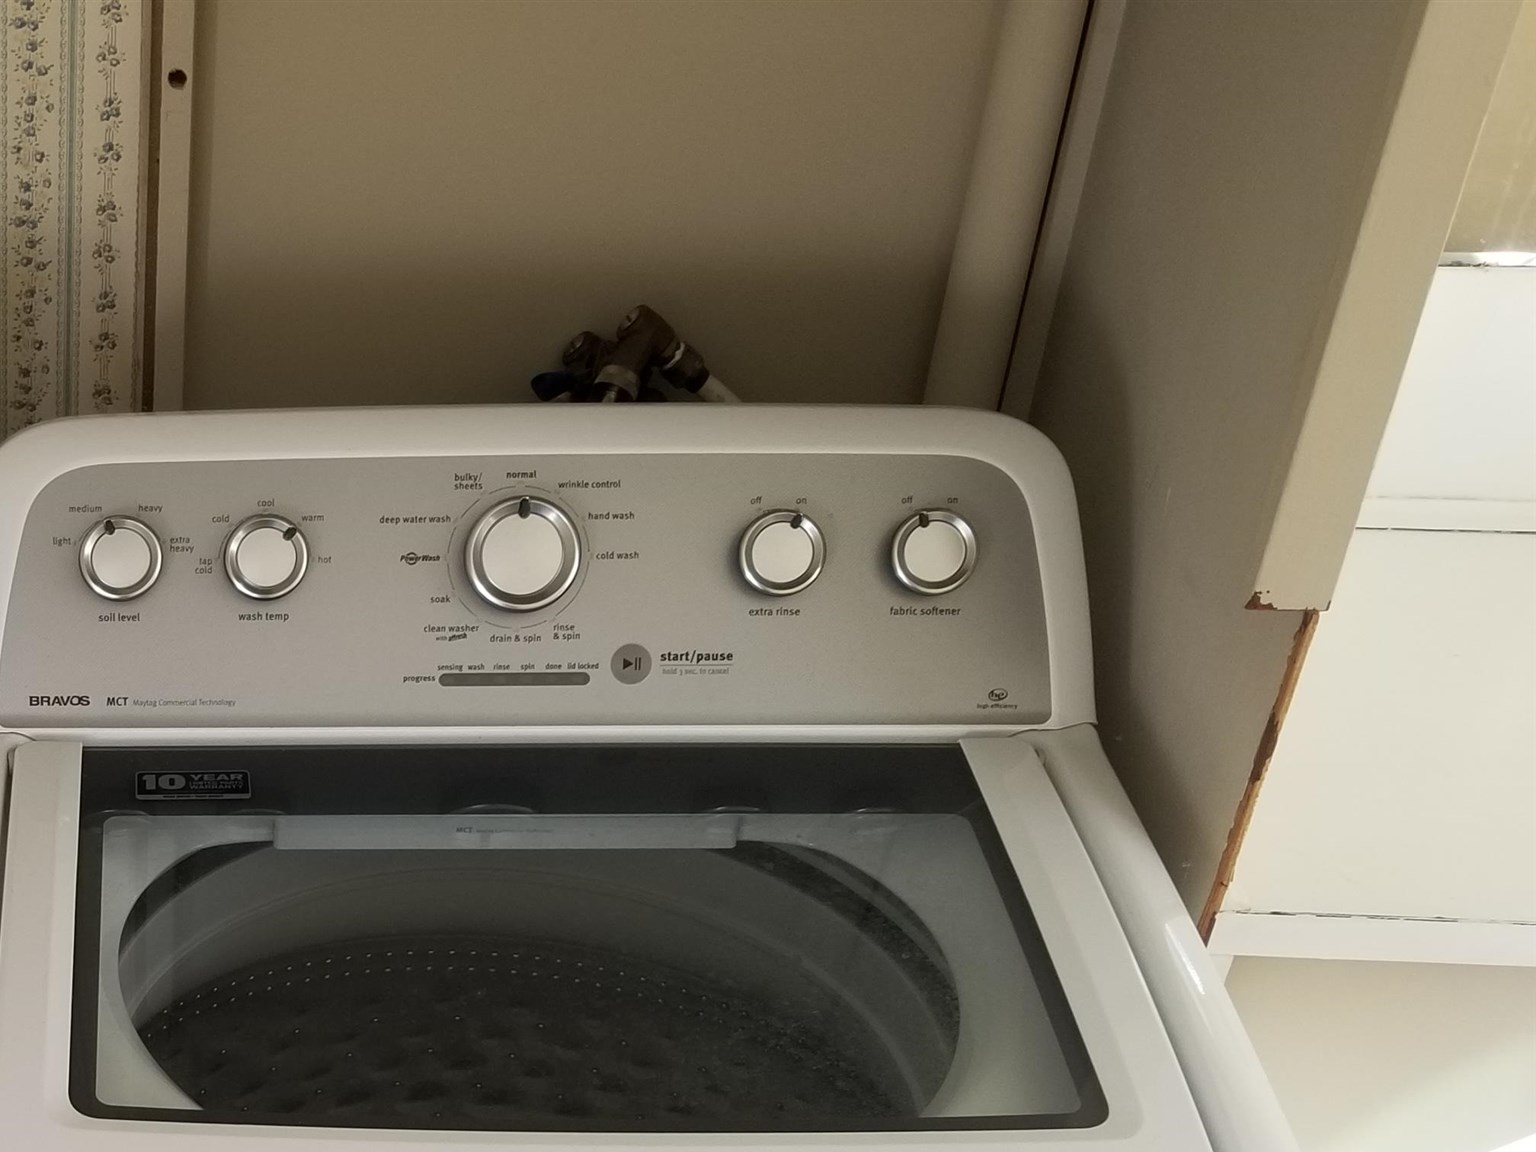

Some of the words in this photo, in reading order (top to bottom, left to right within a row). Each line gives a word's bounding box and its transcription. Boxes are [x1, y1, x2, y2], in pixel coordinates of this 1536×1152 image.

[454, 472, 483, 483] bulky/
[506, 470, 537, 479] normal
[454, 482, 483, 490] sheets
[558, 480, 589, 488] wrinkle
[591, 480, 621, 488] control
[257, 498, 275, 508] cool
[750, 496, 762, 505] off
[796, 497, 807, 505] on
[901, 495, 913, 504] off
[947, 496, 958, 504] on
[68, 504, 103, 513] medium
[138, 504, 163, 514] heavy
[211, 514, 230, 523] cold
[301, 514, 325, 522] warm
[379, 515, 400, 525] deep
[429, 515, 451, 523] wash
[588, 511, 610, 520] hand
[612, 511, 635, 520] wash
[52, 536, 71, 547] light
[169, 536, 190, 544] extra
[169, 544, 194, 554] heavy
[318, 555, 332, 564] hot
[400, 553, 440, 564] PowerWash
[595, 551, 614, 560] cold
[616, 551, 640, 560] wash
[199, 557, 213, 567] tap
[194, 566, 213, 575] cold
[430, 594, 451, 604] soak
[748, 607, 774, 616] extra
[776, 606, 801, 616] rinse
[889, 605, 917, 616] fabric
[920, 605, 961, 616] softener
[98, 612, 115, 622] soil
[118, 612, 140, 622] level
[238, 612, 263, 621] wash
[265, 612, 290, 623] temp
[423, 624, 446, 633] clean
[448, 624, 479, 633] washer
[553, 624, 575, 632] rinse
[489, 634, 512, 643] drain
[514, 634, 521, 642] &
[522, 634, 541, 644] spin
[553, 632, 559, 640] &
[562, 632, 581, 641] spin
[660, 650, 734, 664] start/pause
[437, 663, 463, 672] sensing
[520, 663, 535, 671] spin
[545, 662, 562, 670] done
[567, 662, 576, 670] lid
[577, 662, 599, 670] locked
[403, 675, 436, 683] progress
[29, 695, 91, 707] BRAVOS
[106, 696, 129, 707] MCT
[133, 698, 157, 708] Maytag
[158, 698, 197, 707] Commercial
[198, 698, 236, 708] Technology
[142, 774, 186, 790] 10
